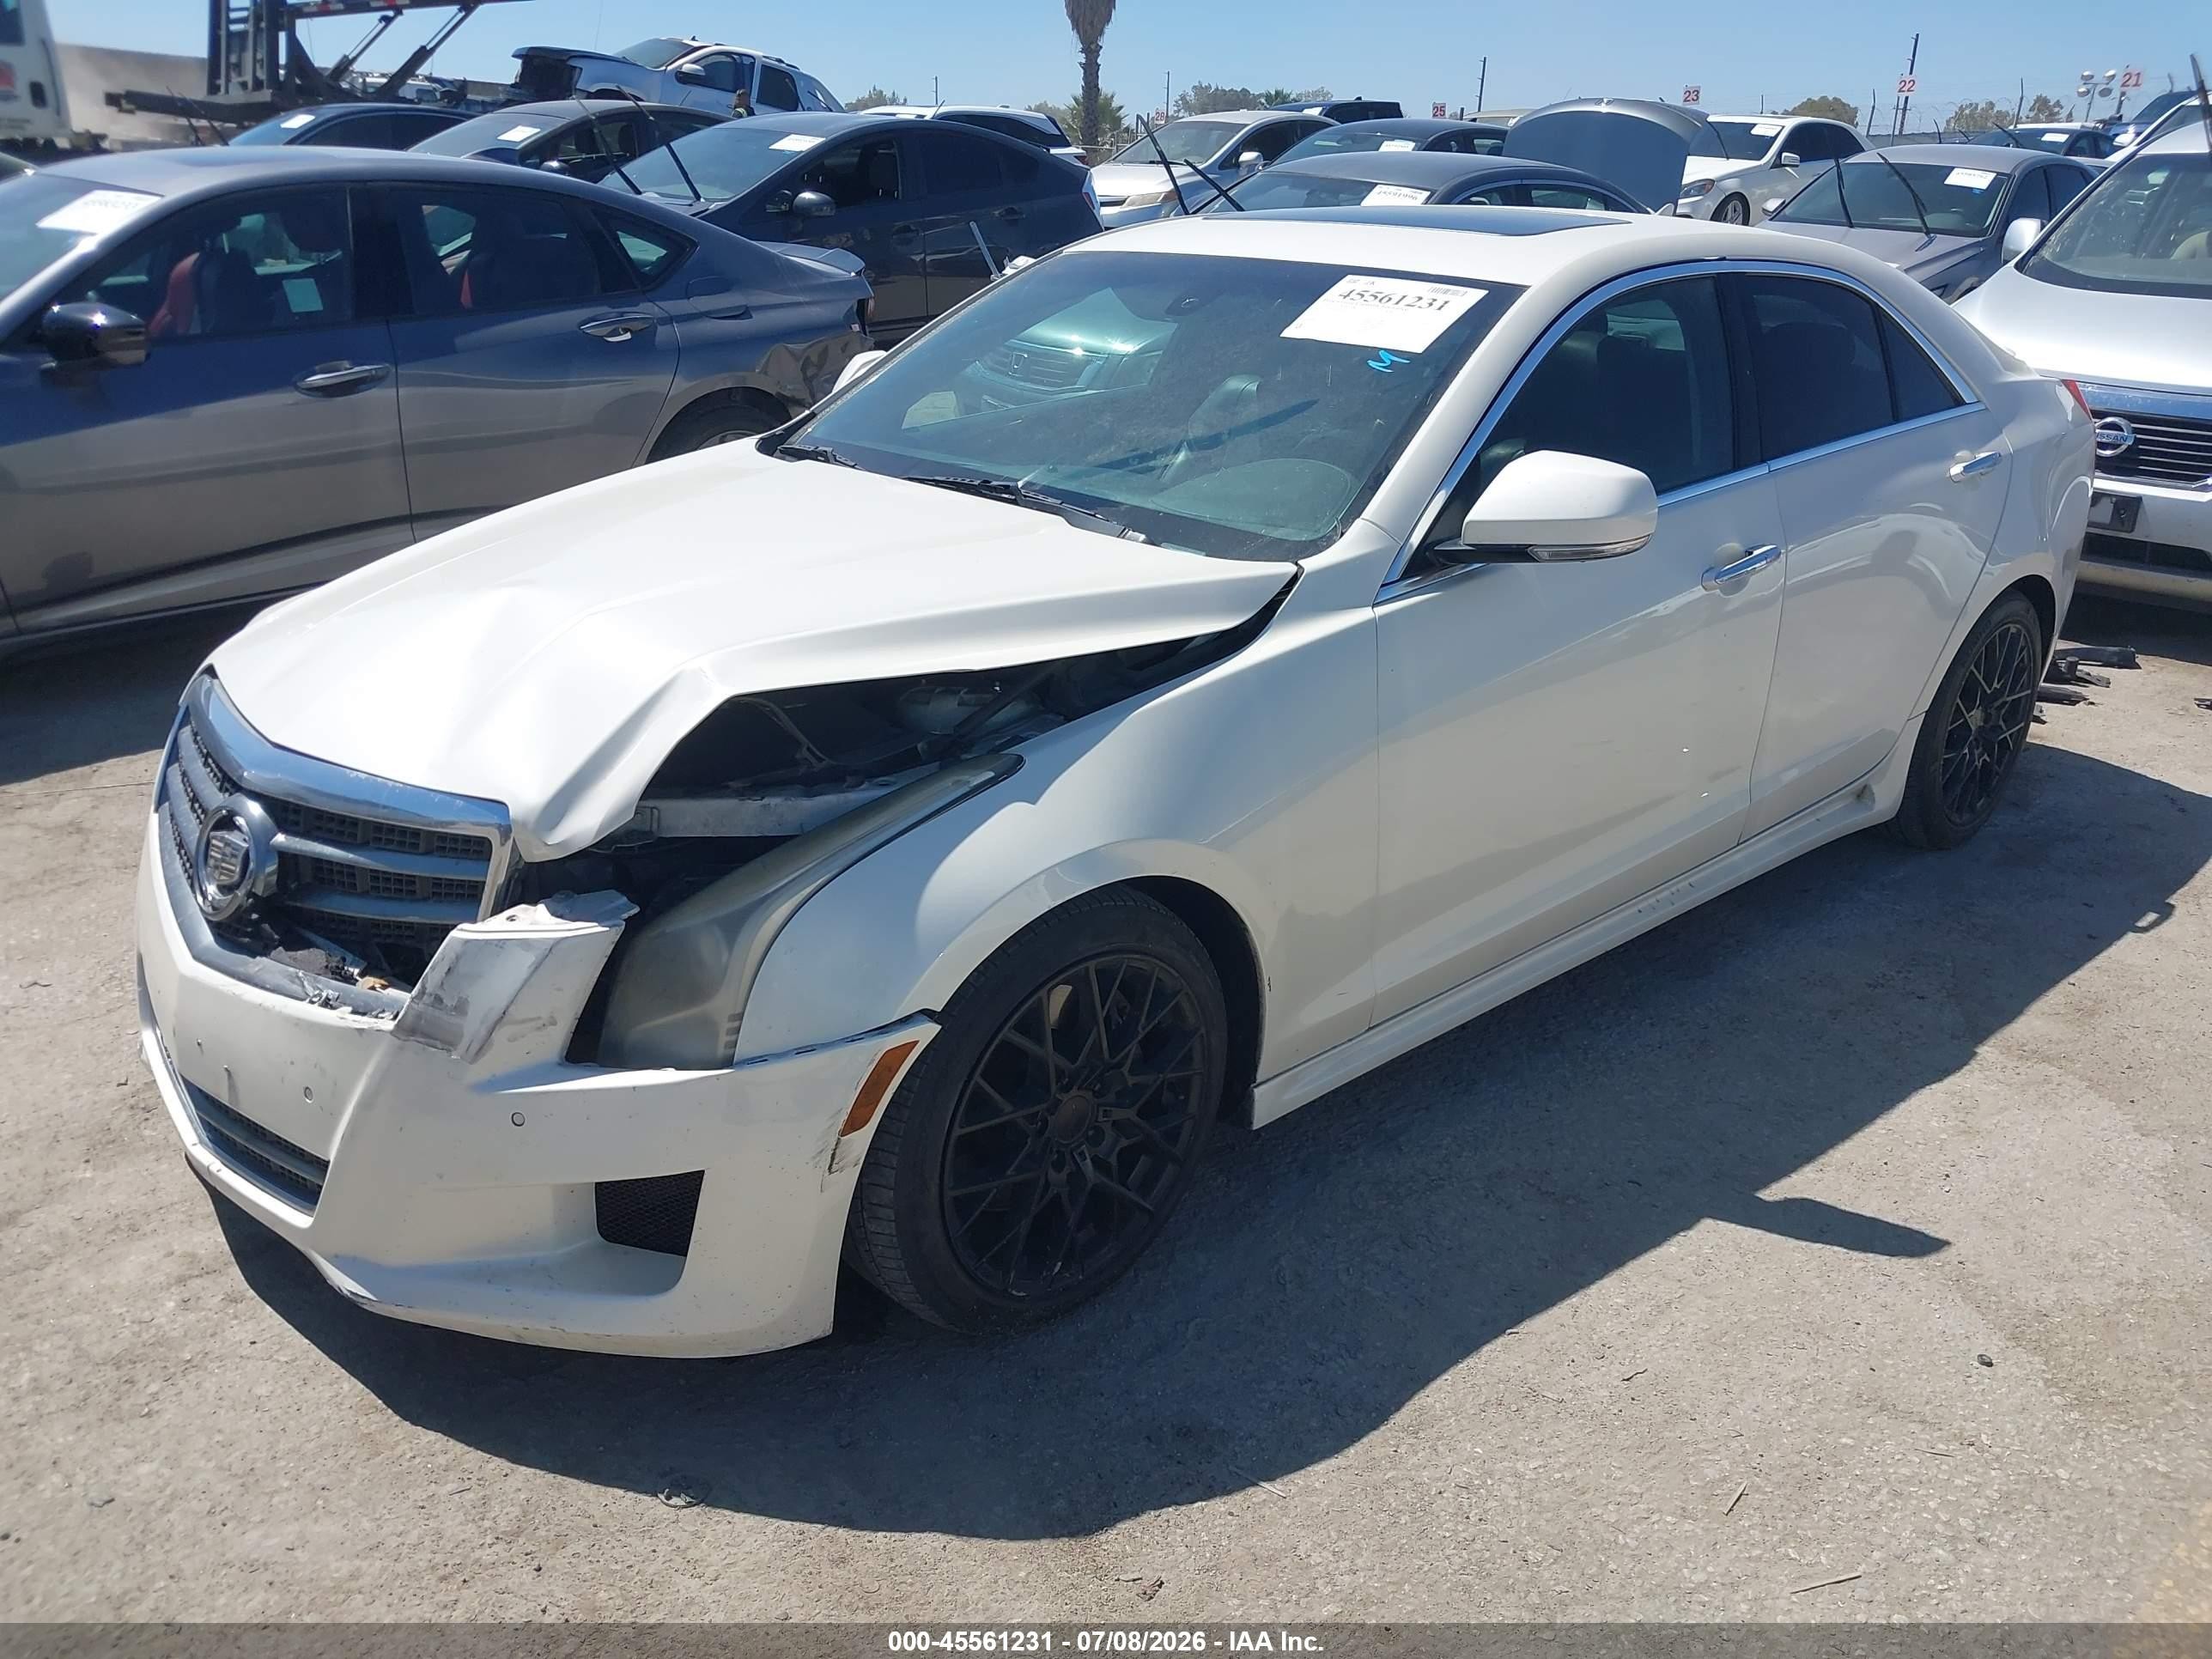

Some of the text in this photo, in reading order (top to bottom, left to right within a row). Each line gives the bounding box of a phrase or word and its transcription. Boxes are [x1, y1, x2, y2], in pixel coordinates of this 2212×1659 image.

[1897, 79, 1916, 93] 22
[2120, 72, 2142, 88] 21
[1683, 89, 1699, 102] 23
[1155, 112, 1165, 122] 28
[1432, 106, 1446, 118] 25
[1337, 289, 1450, 312] 45561231
[2096, 432, 2129, 442] ISSAN
